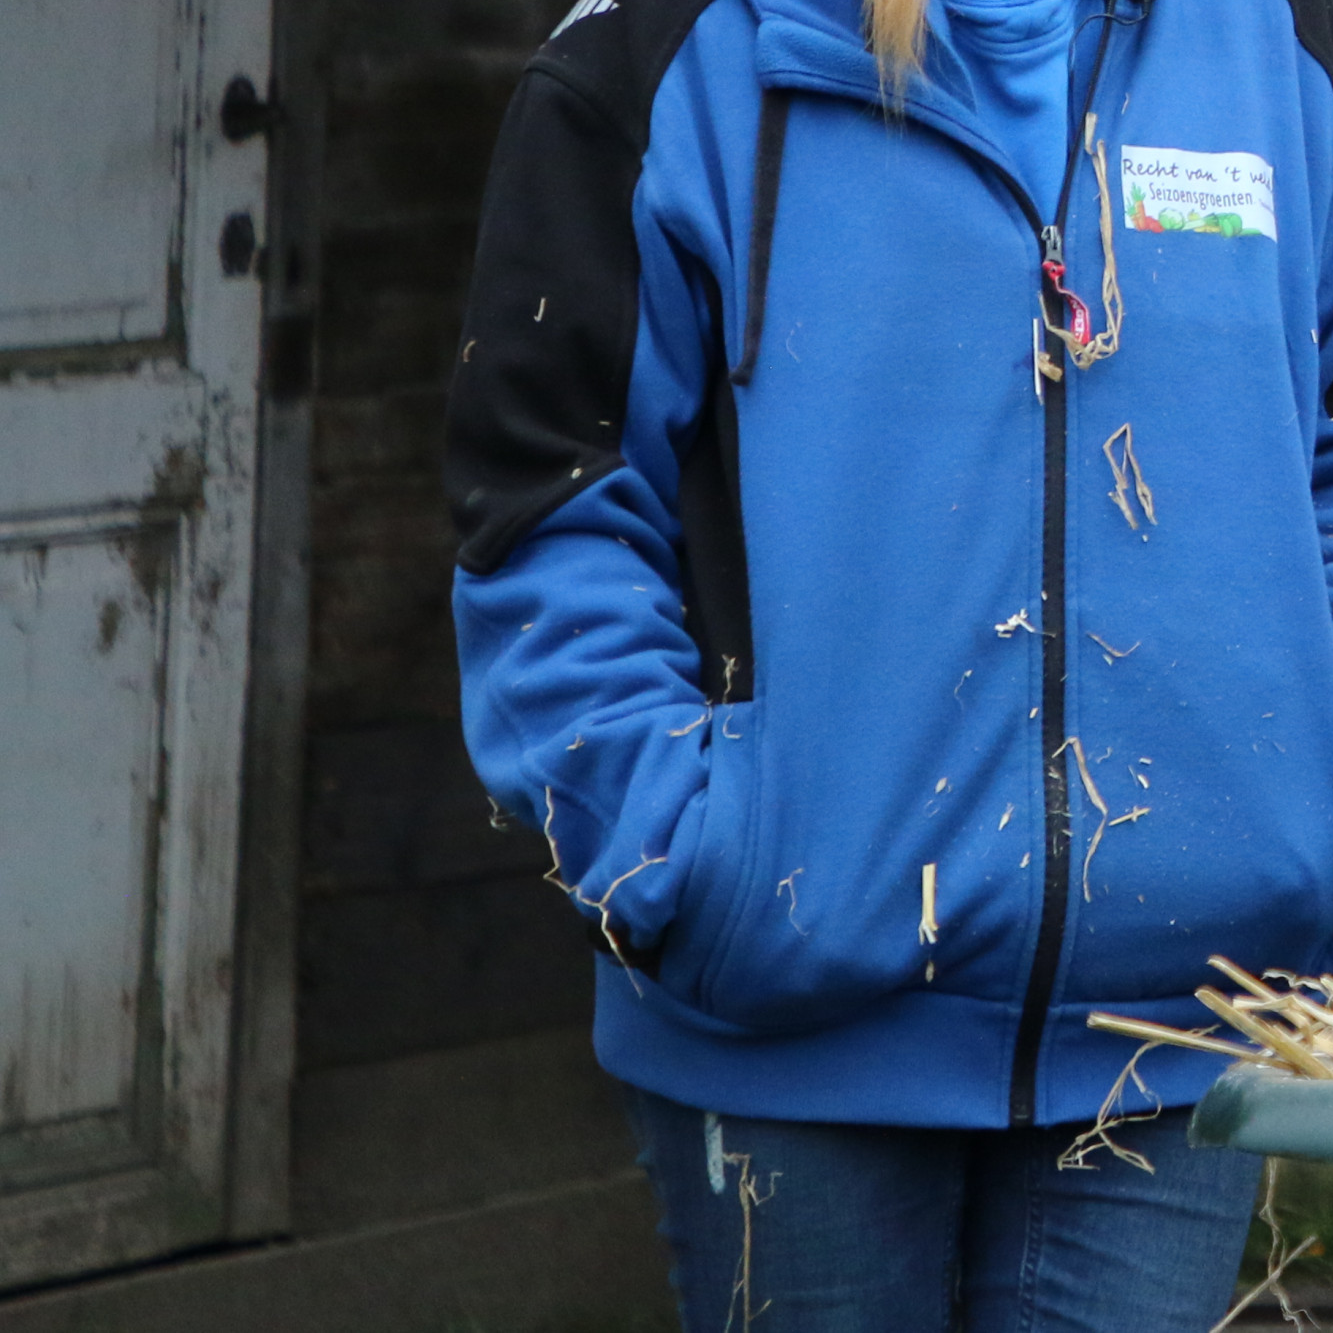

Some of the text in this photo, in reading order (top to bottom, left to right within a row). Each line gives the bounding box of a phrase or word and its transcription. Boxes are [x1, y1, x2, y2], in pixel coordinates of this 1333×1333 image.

[1122, 158, 1179, 178] Recht
[1185, 168, 1217, 182] van
[1148, 181, 1253, 210] Seizoensgroenten
